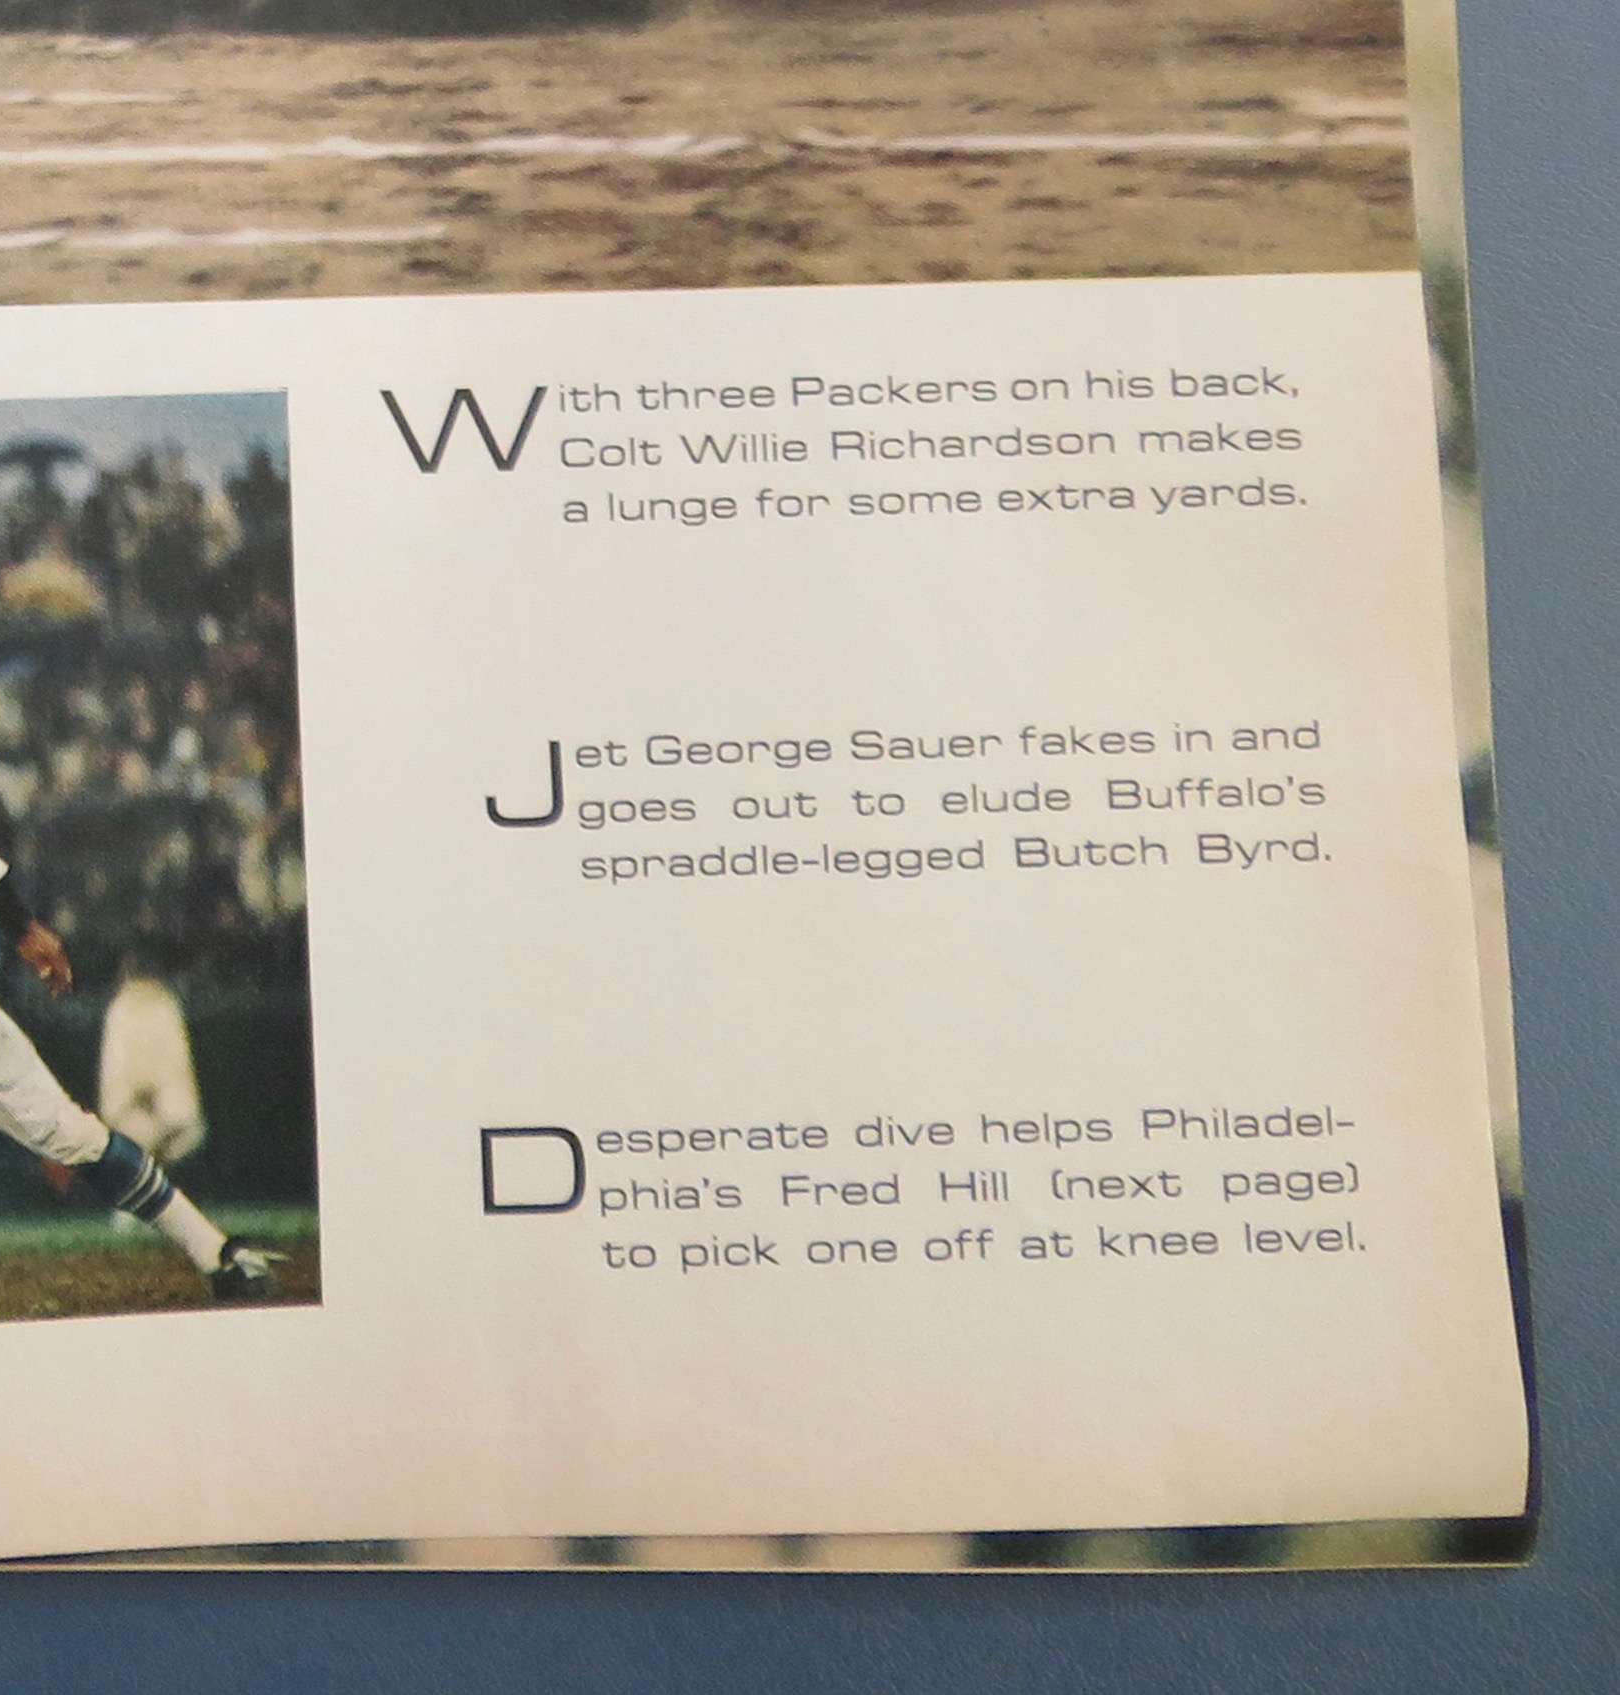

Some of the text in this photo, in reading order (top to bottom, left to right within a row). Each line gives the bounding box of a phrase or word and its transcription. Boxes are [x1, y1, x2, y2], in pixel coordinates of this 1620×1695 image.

[635, 380, 776, 411] three
[790, 374, 998, 408] Packers
[1009, 378, 1070, 402] on
[1084, 369, 1155, 400] his
[1169, 365, 1299, 399] back,
[559, 422, 1303, 469] Colt Willie Richardson makes
[562, 475, 1308, 527] a lunge for some extra yards.
[645, 734, 833, 770] George
[849, 729, 1004, 761] Sauer
[1018, 724, 1156, 756] fakes
[1173, 729, 1213, 753] in
[1231, 719, 1321, 752] and
[577, 774, 1327, 831] goes out to elude Buffalo's
[581, 830, 1332, 886] spraddle-legged Butch Byrd.
[854, 1114, 955, 1148] dive
[979, 1111, 1114, 1150] helps
[1140, 1105, 1356, 1141] Philadel-
[598, 1160, 1360, 1218] phia's Fred Hill (next page)
[600, 1220, 1367, 1275] to pick one off at knee level.
